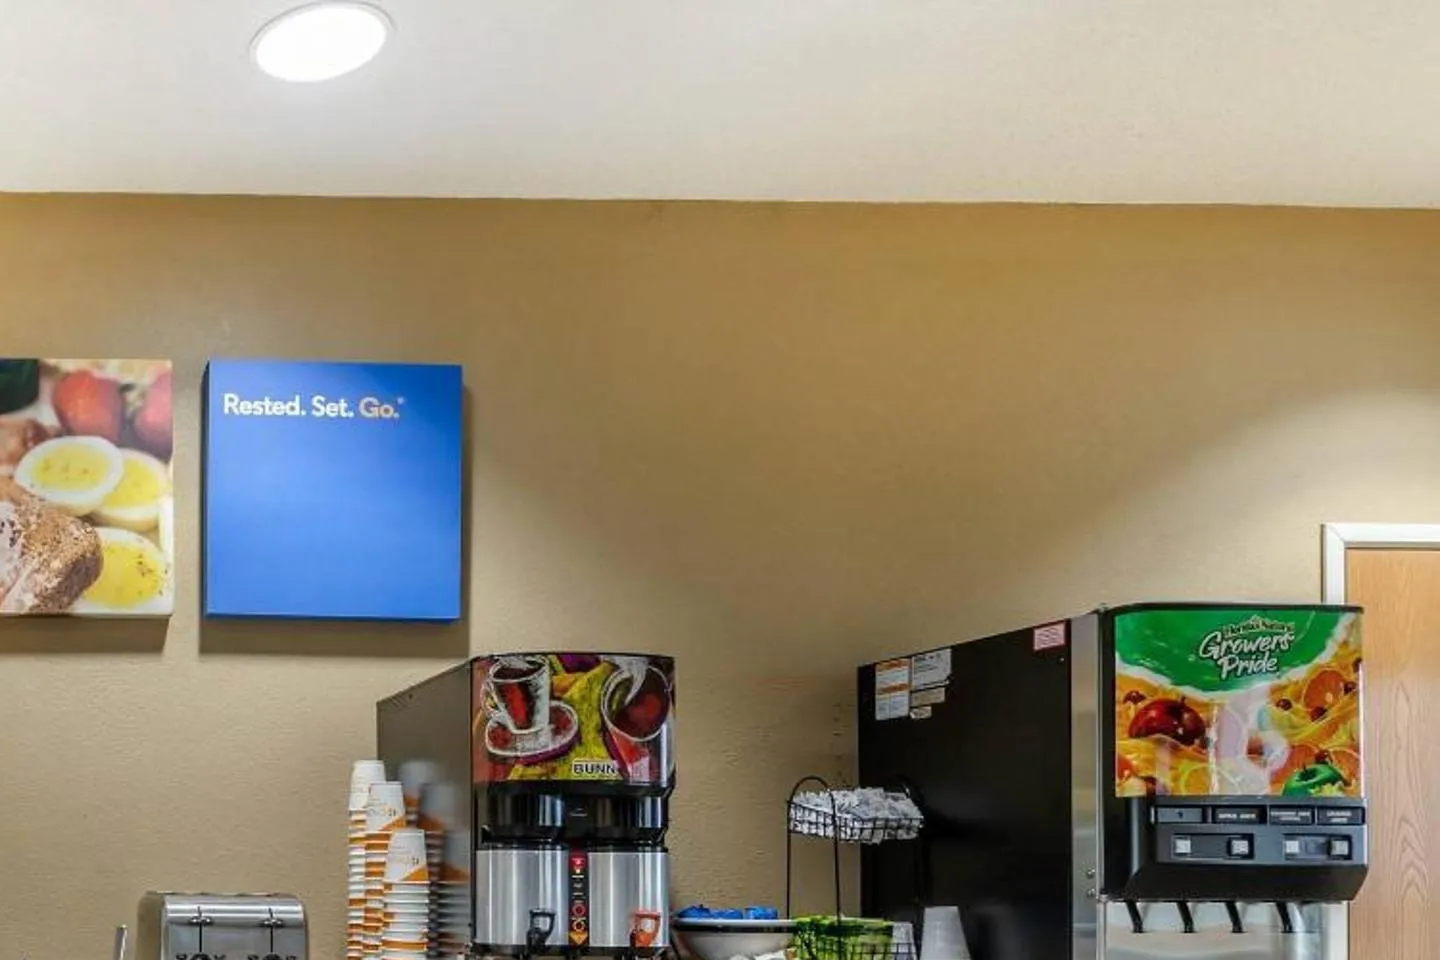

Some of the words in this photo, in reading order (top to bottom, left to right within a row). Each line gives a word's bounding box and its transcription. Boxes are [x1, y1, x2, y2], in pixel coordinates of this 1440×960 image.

[223, 393, 306, 416] Rested.
[311, 395, 355, 417] Set.
[1217, 650, 1278, 680] Pride
[573, 763, 616, 775] BUNN
